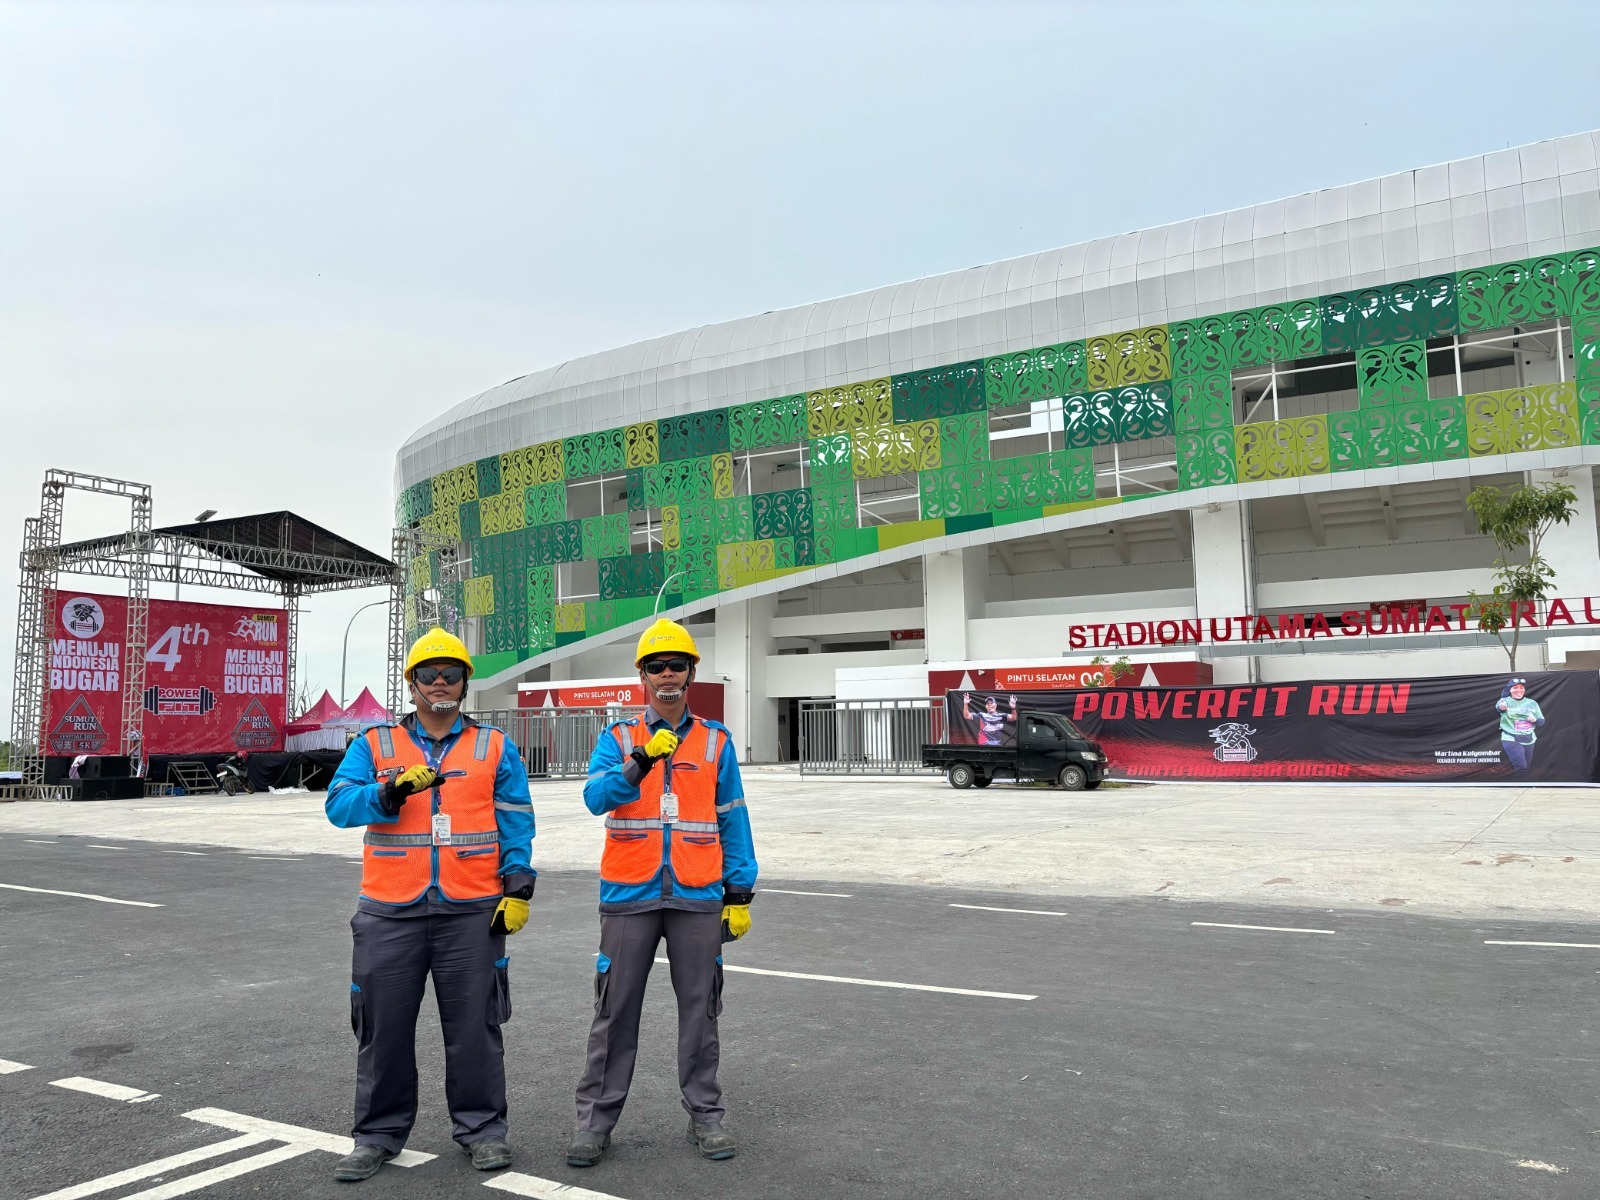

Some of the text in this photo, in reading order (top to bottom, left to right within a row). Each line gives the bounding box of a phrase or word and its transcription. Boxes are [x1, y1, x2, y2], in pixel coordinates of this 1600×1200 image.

[255, 621, 277, 641] RUN
[1069, 618, 1202, 648] STADION
[1211, 612, 1333, 641] UTAMA
[49, 639, 119, 658] MENUJU
[146, 623, 209, 671] 4th
[225, 648, 283, 664] MENUJU
[224, 663, 283, 676] INDONESIA
[1007, 674, 1034, 682] PINTU
[1036, 673, 1075, 682] SELATAN
[50, 669, 119, 691] BUGAR
[224, 676, 284, 694] BUGAR
[159, 688, 200, 699] POWER
[617, 690, 631, 702] 08
[1073, 684, 1411, 720] POWERFIT RUN
[73, 722, 97, 731] RUN
